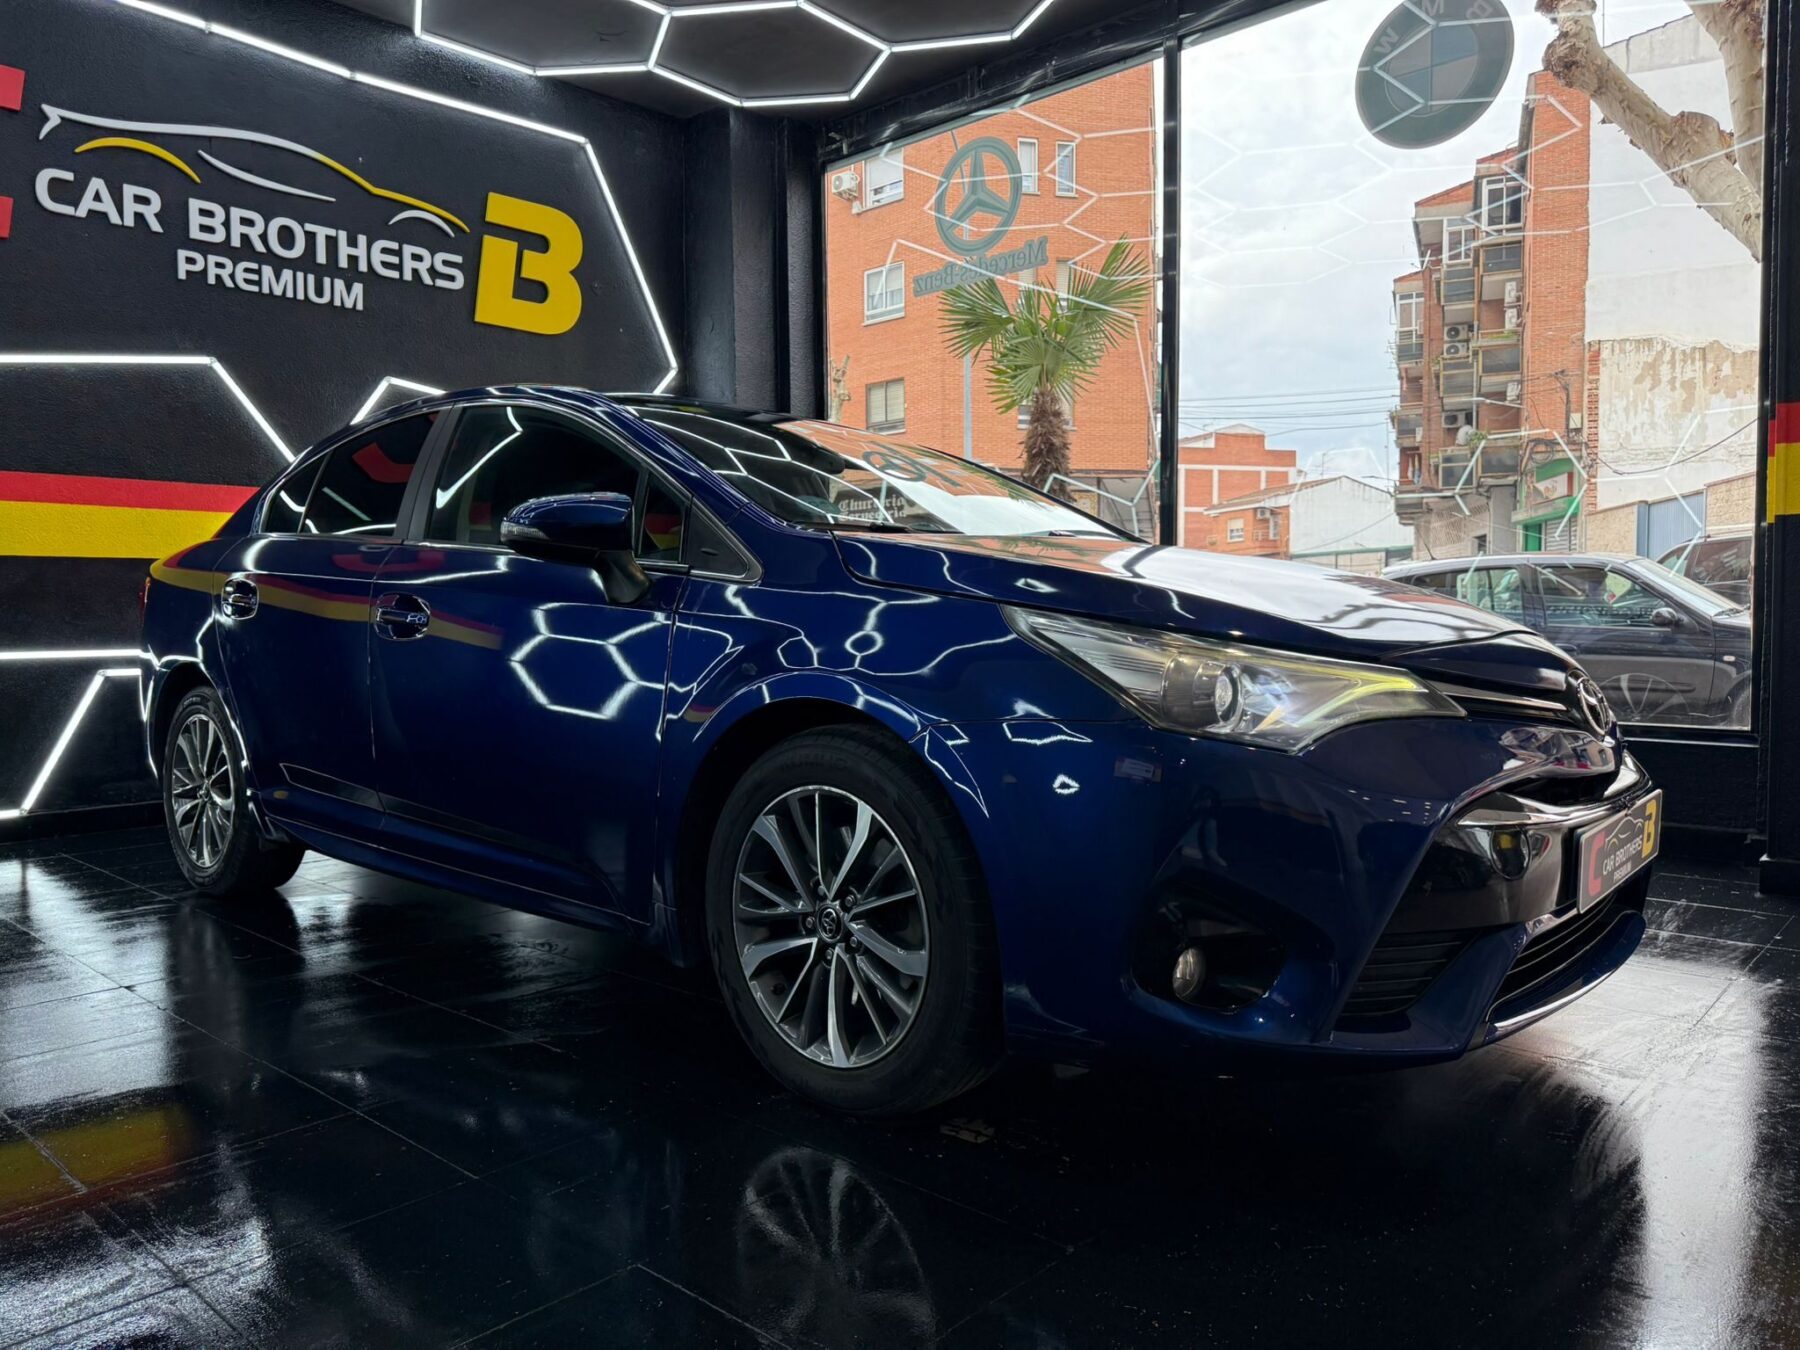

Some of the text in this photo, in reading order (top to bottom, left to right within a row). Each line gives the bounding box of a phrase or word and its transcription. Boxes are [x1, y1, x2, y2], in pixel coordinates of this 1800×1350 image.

[34, 168, 465, 290] CAR BROTHERS
[176, 249, 364, 311] PREMIUM
[1602, 834, 1643, 876] CAR BROTHERS
